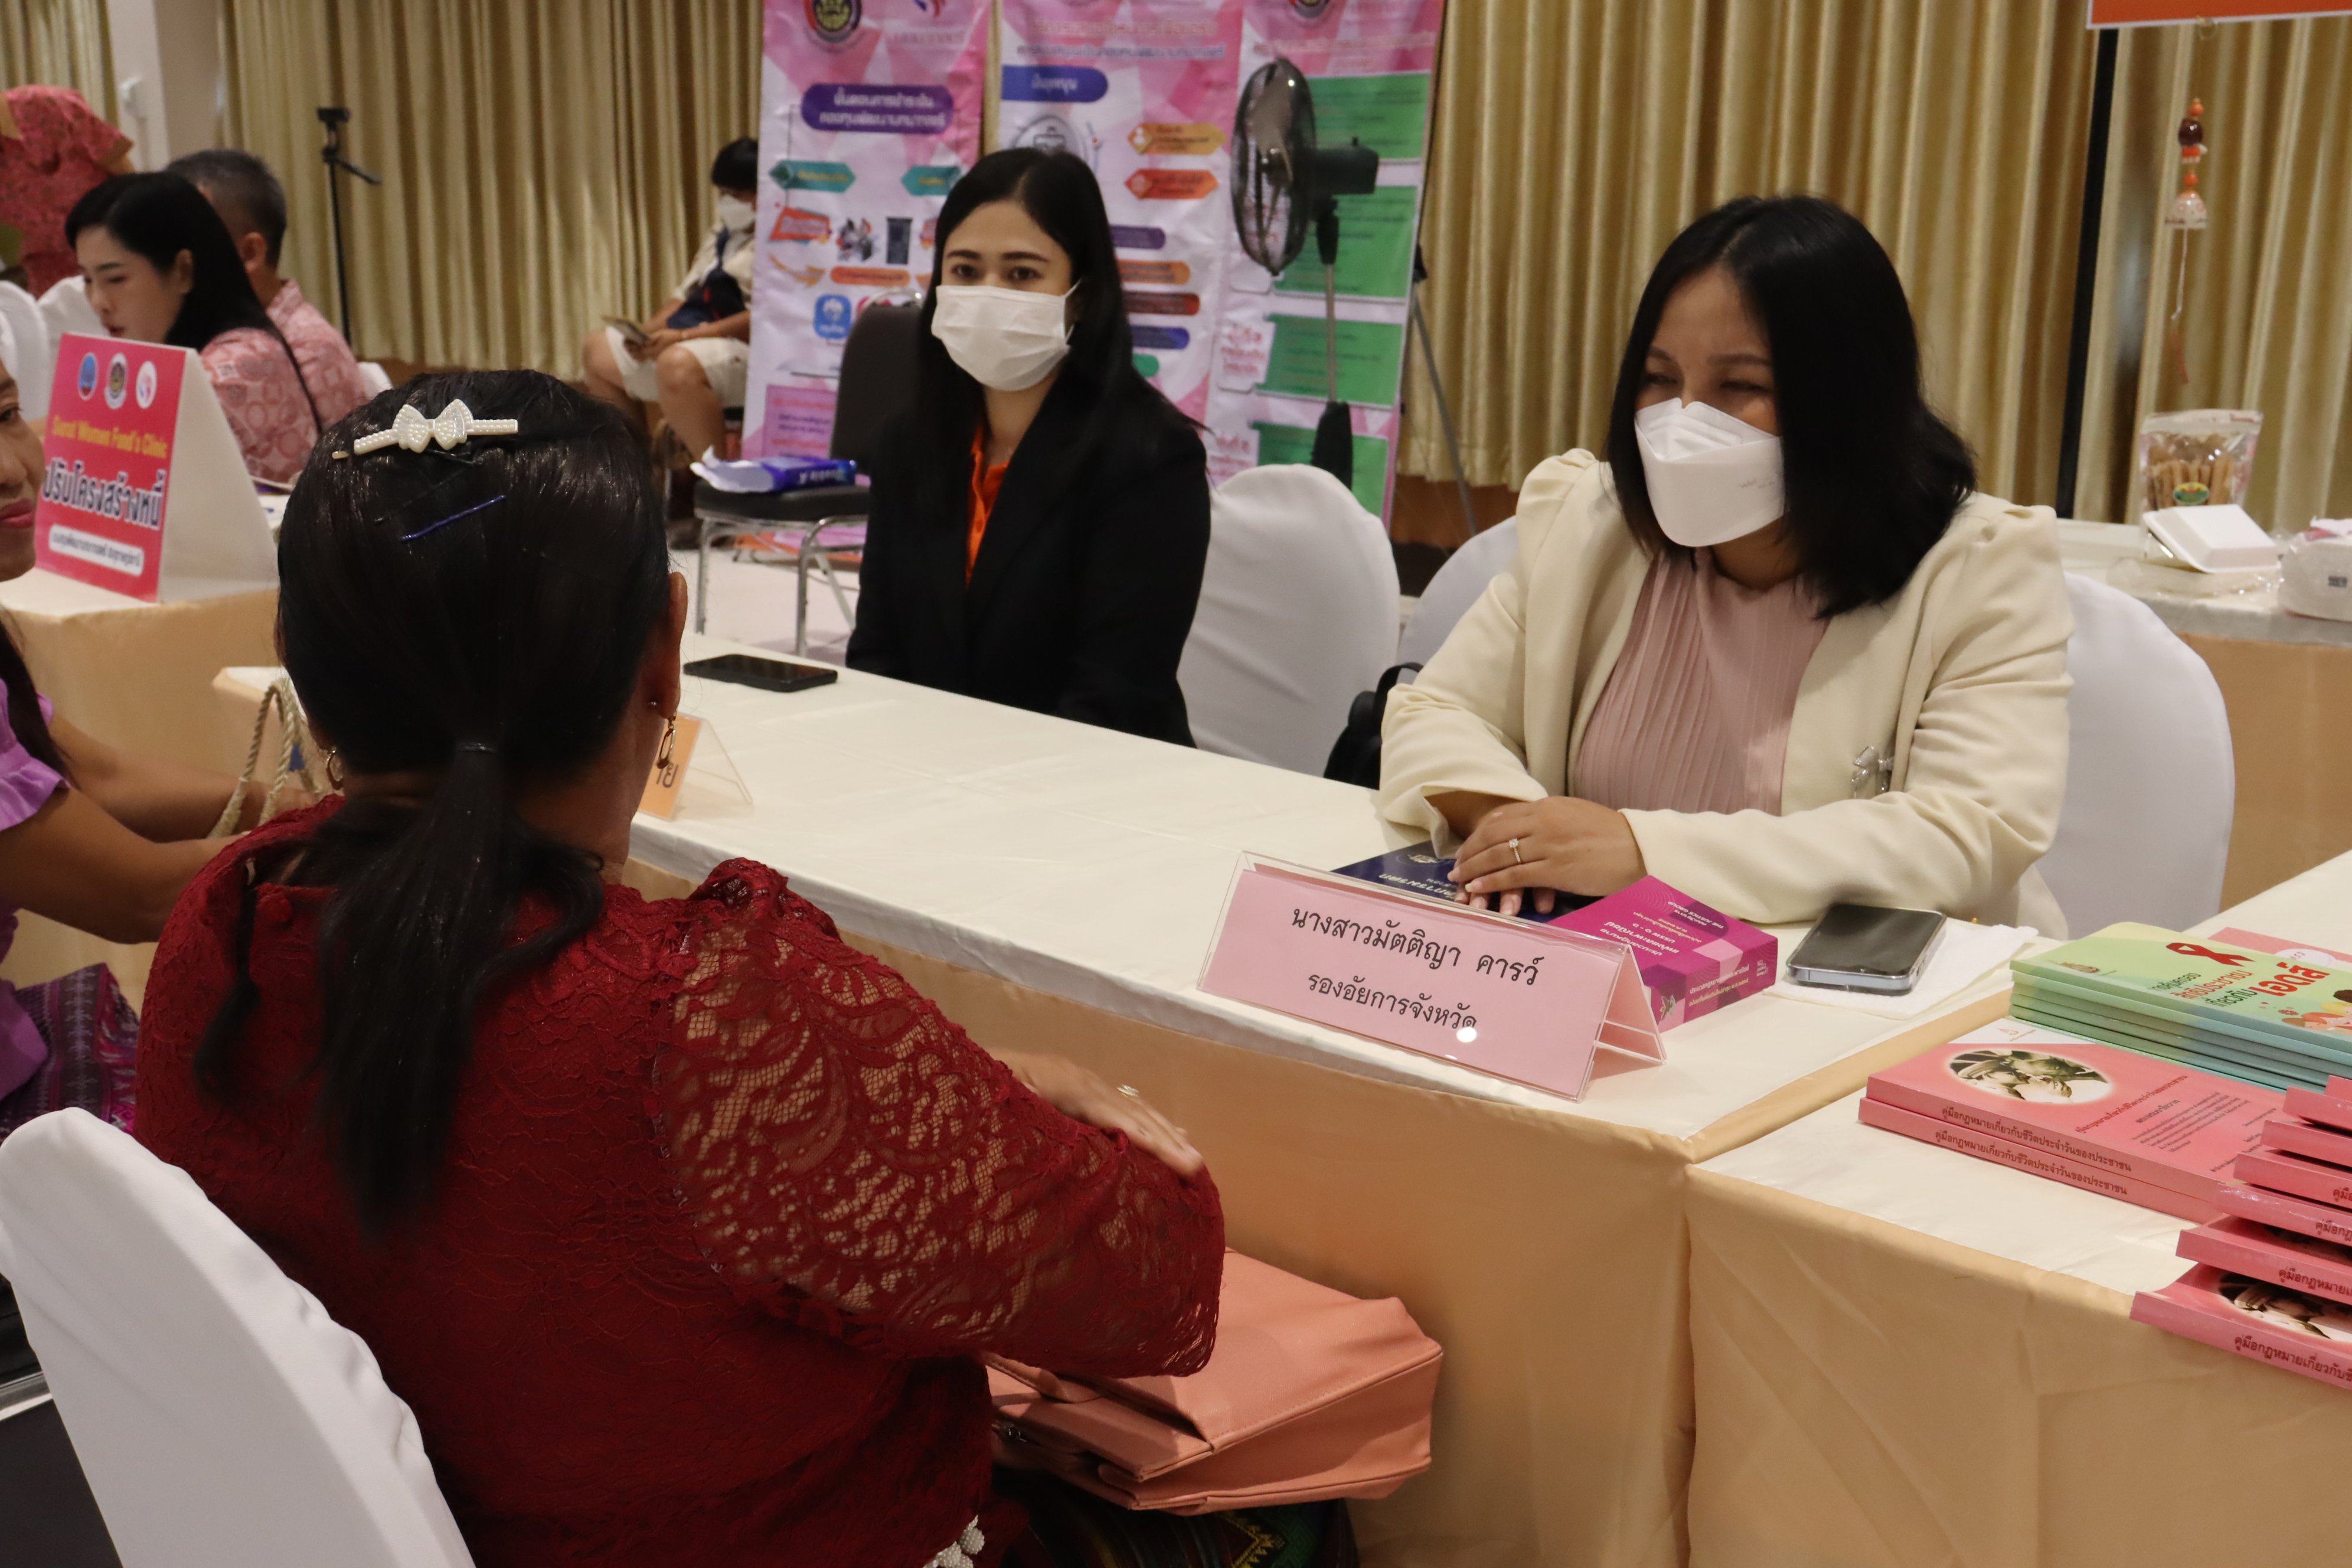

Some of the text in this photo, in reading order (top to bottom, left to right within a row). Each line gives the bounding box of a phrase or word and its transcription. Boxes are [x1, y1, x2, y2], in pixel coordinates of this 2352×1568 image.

[42, 457, 166, 530] ปรับโครงสร้างหนี้
[1668, 901, 1689, 913] GROUP
[1689, 911, 1713, 923] JUSTICE
[1292, 908, 1545, 986] นางสาวมัตติญา คารว์
[1603, 921, 1680, 954] แพ่งและพาณิชย์
[1651, 932, 1675, 943] บรรพ
[2170, 969, 2255, 999] สิทธิประชาชน
[2248, 962, 2331, 997] เอดส์
[1308, 974, 1477, 1030] รองอัยการจังหวัด
[2201, 989, 2258, 1007] เกี่ยวกับ
